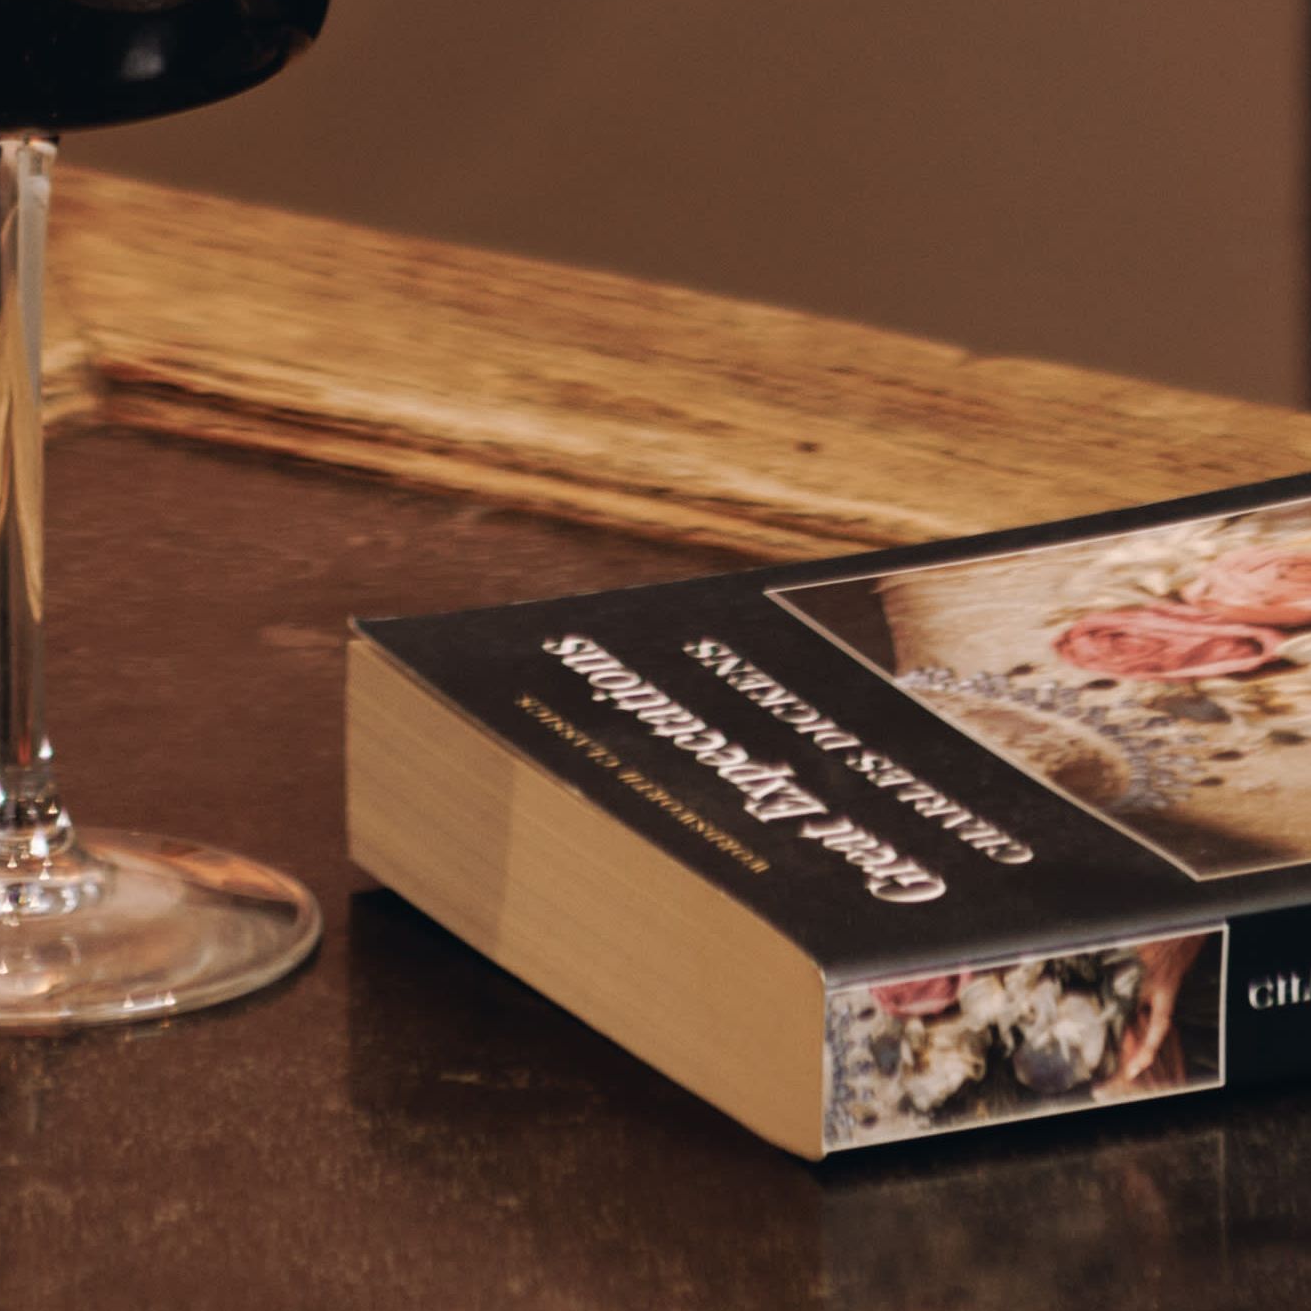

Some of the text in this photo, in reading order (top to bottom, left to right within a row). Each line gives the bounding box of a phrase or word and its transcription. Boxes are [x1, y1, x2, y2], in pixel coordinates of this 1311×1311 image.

[541, 634, 947, 903] Great Expectations
[682, 637, 1035, 864] CHARLES DICKENS
